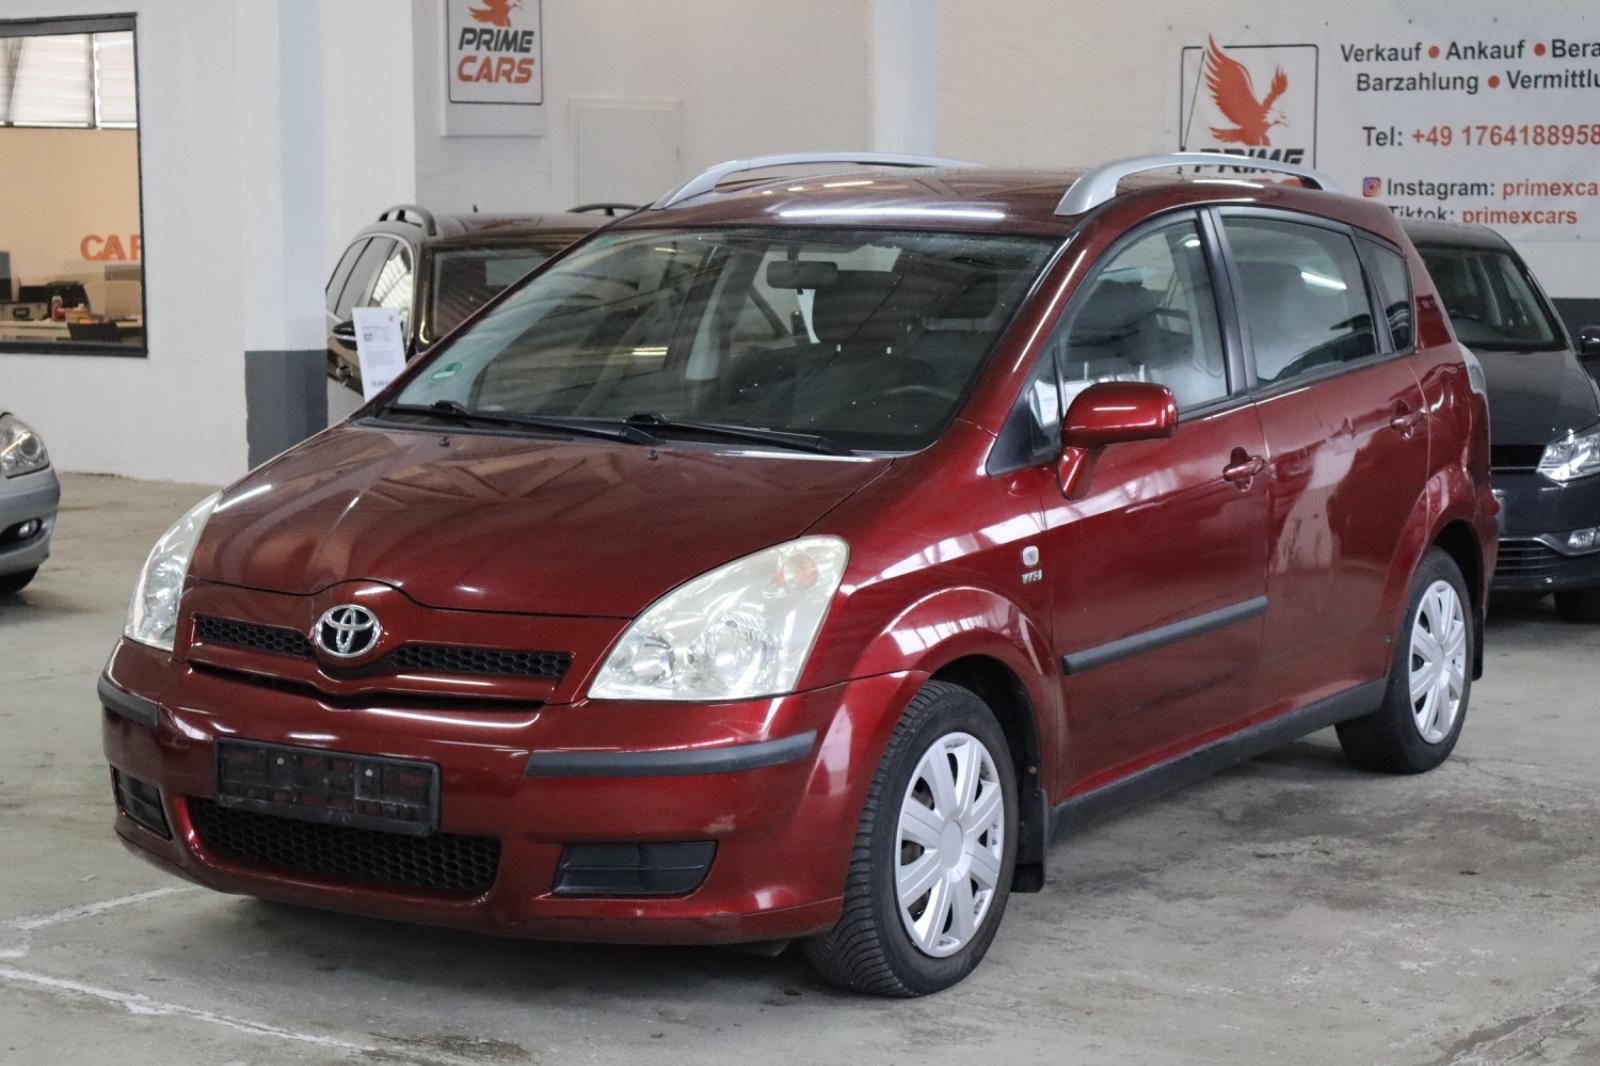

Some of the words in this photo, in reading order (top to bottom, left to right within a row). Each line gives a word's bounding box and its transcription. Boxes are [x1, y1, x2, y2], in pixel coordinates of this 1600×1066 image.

[458, 27, 534, 53] PRIME
[1340, 41, 1422, 62] Verkauf
[1445, 39, 1526, 60] Ankauf
[1551, 38, 1600, 59] Bera
[457, 55, 535, 83] CARS
[1356, 71, 1479, 95] Barzahlung
[1362, 125, 1403, 147] Tel:
[1411, 125, 1453, 147] +49
[1461, 123, 1600, 146] 1764188958
[1387, 177, 1495, 201] Instagram:
[1502, 178, 1599, 201] primexca
[1461, 205, 1578, 224] primexcars
